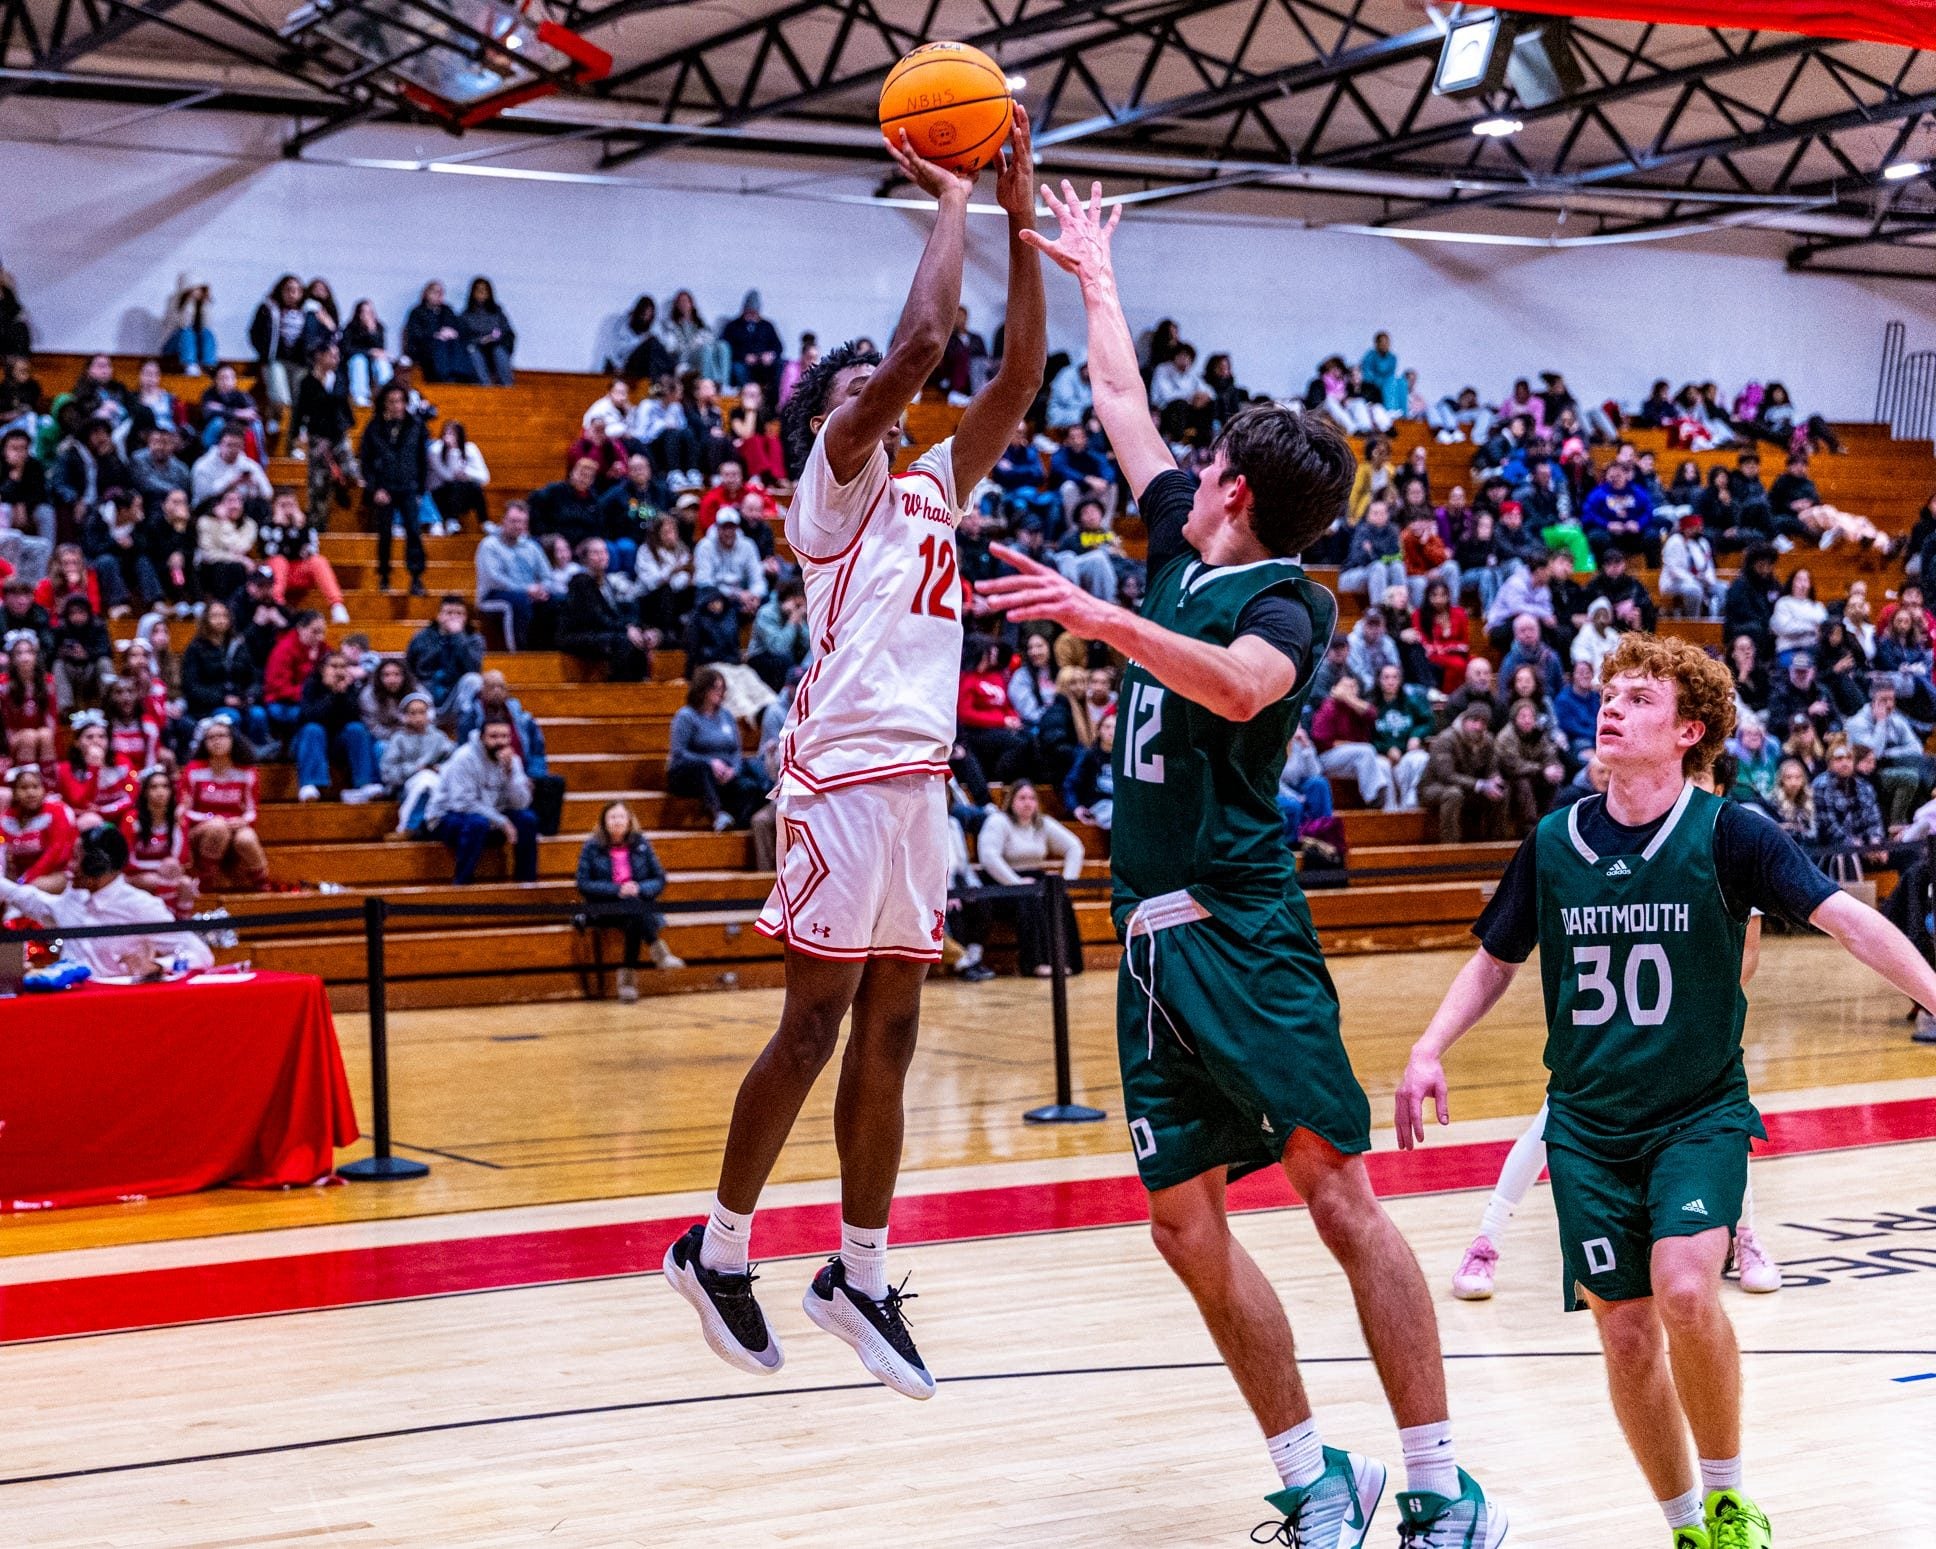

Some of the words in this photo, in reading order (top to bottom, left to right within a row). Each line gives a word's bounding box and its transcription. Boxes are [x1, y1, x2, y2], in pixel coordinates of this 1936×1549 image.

[906, 88, 955, 112] NBHS
[910, 533, 957, 622] 12
[1123, 681, 1165, 784] 12
[1606, 869, 1632, 877] adidas
[1560, 903, 1689, 936] DARTMOUTH
[1572, 943, 1673, 1026] 30
[1129, 1117, 1157, 1160] D
[1681, 1205, 1709, 1216] adidas
[1582, 1237, 1616, 1275] D
